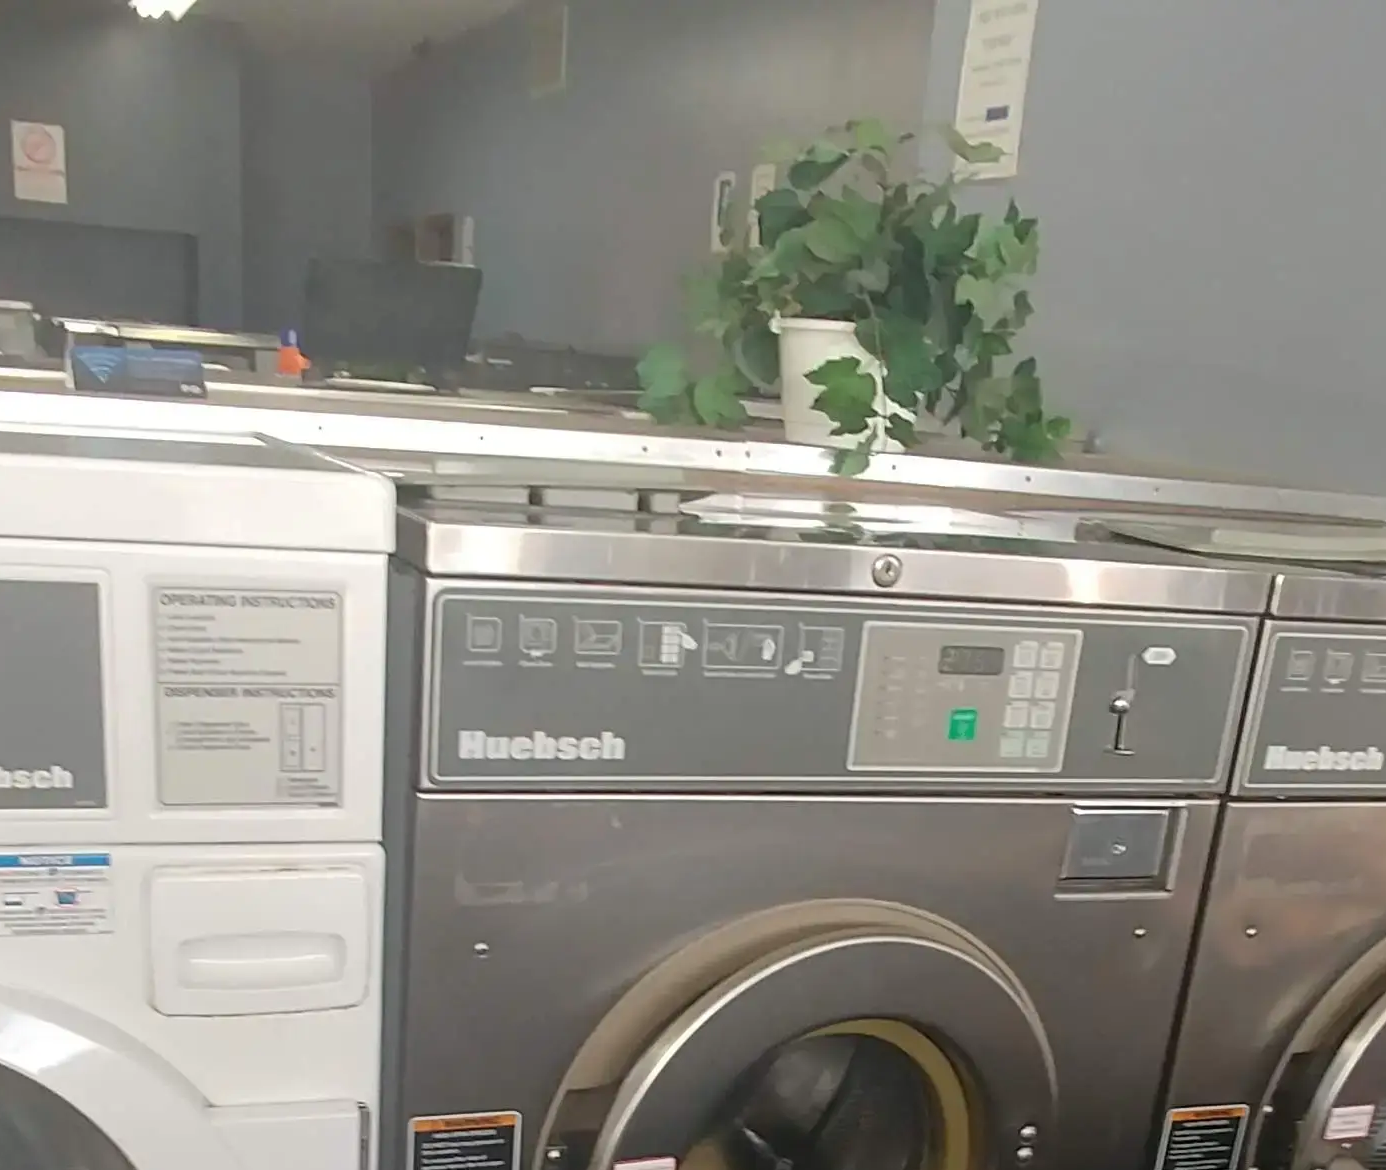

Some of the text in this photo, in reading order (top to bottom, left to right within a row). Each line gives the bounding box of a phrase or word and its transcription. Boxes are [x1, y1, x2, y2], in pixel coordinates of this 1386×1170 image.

[159, 593, 336, 609] OPERATING INSTRUCTIONS
[242, 687, 337, 699] INSTRUCTIONS
[458, 730, 626, 760] Huebsch
[1263, 745, 1384, 771] Huebsch
